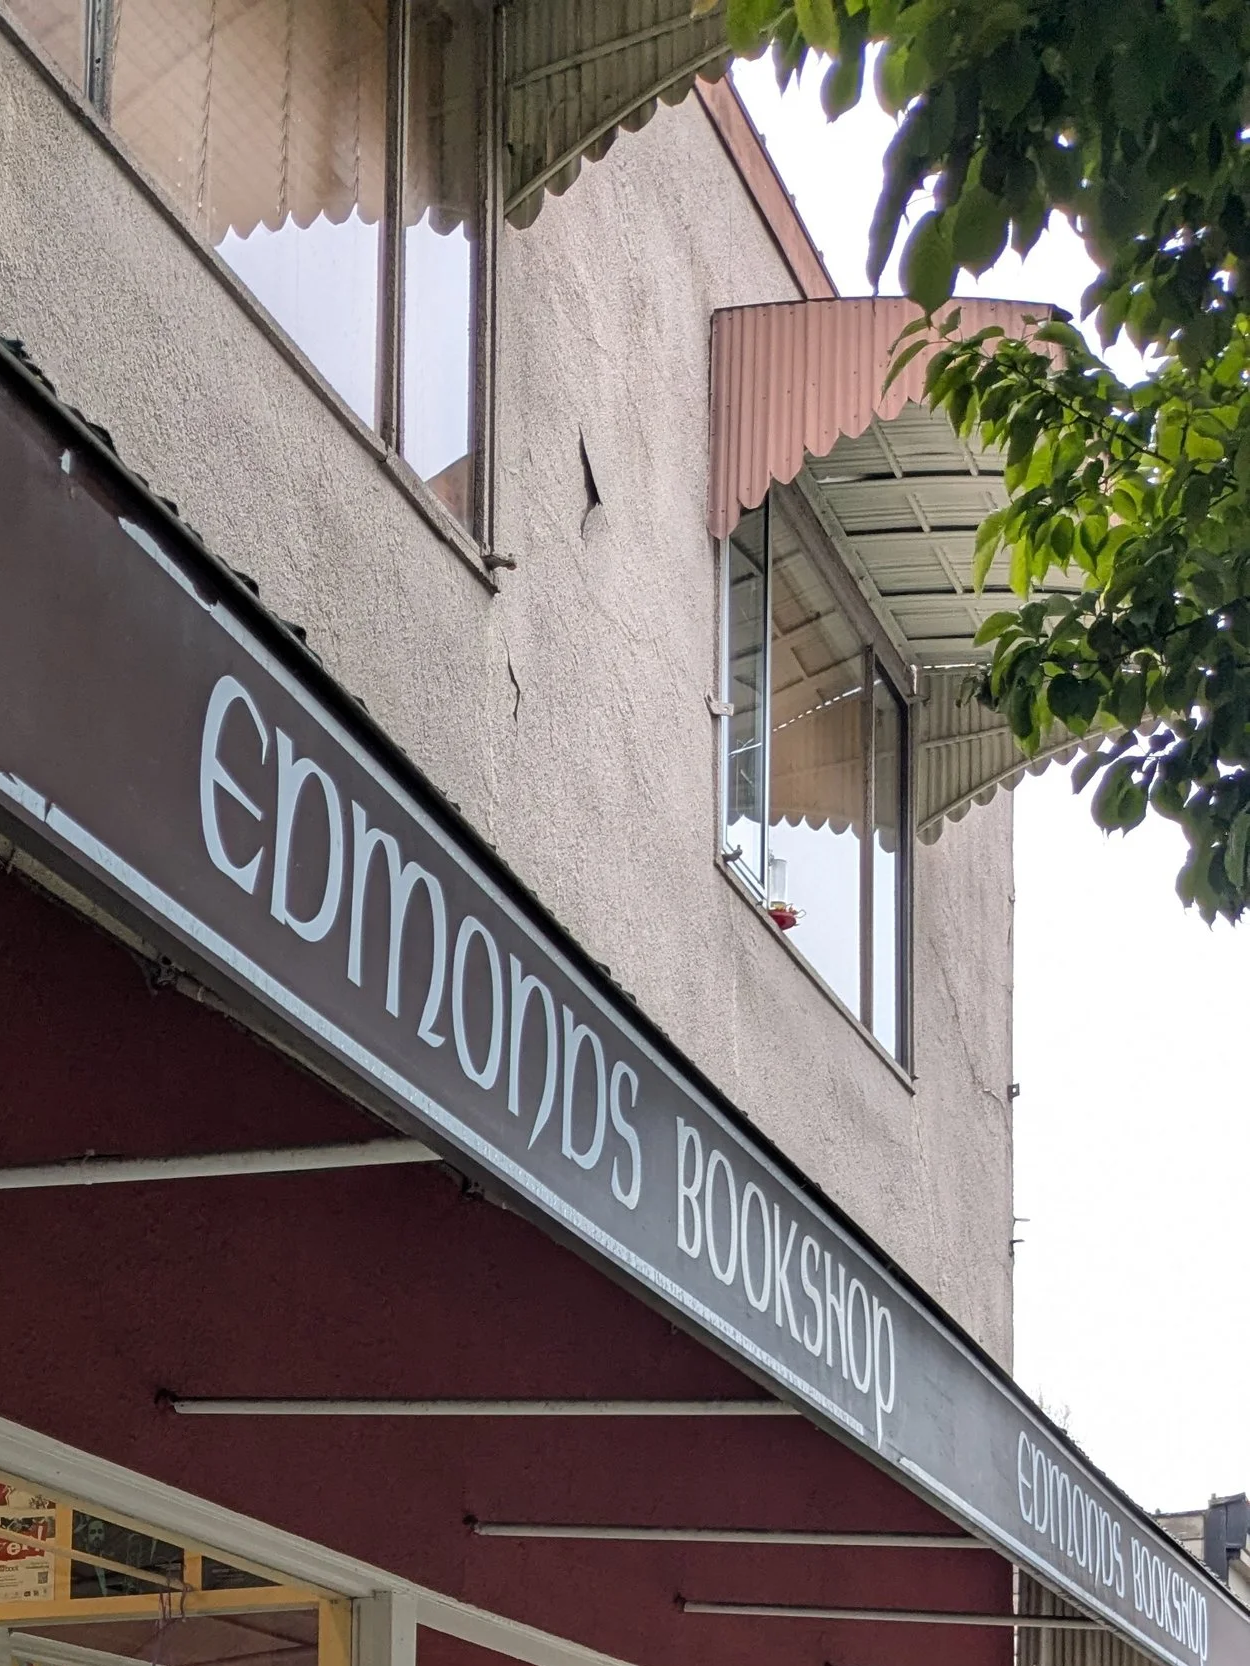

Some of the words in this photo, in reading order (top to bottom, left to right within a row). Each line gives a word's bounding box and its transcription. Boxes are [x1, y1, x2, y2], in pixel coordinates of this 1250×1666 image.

[200, 675, 641, 1210] EDMONDS
[677, 1115, 896, 1449] BOOKSHOP
[1017, 1430, 1125, 1599] EDMONDS
